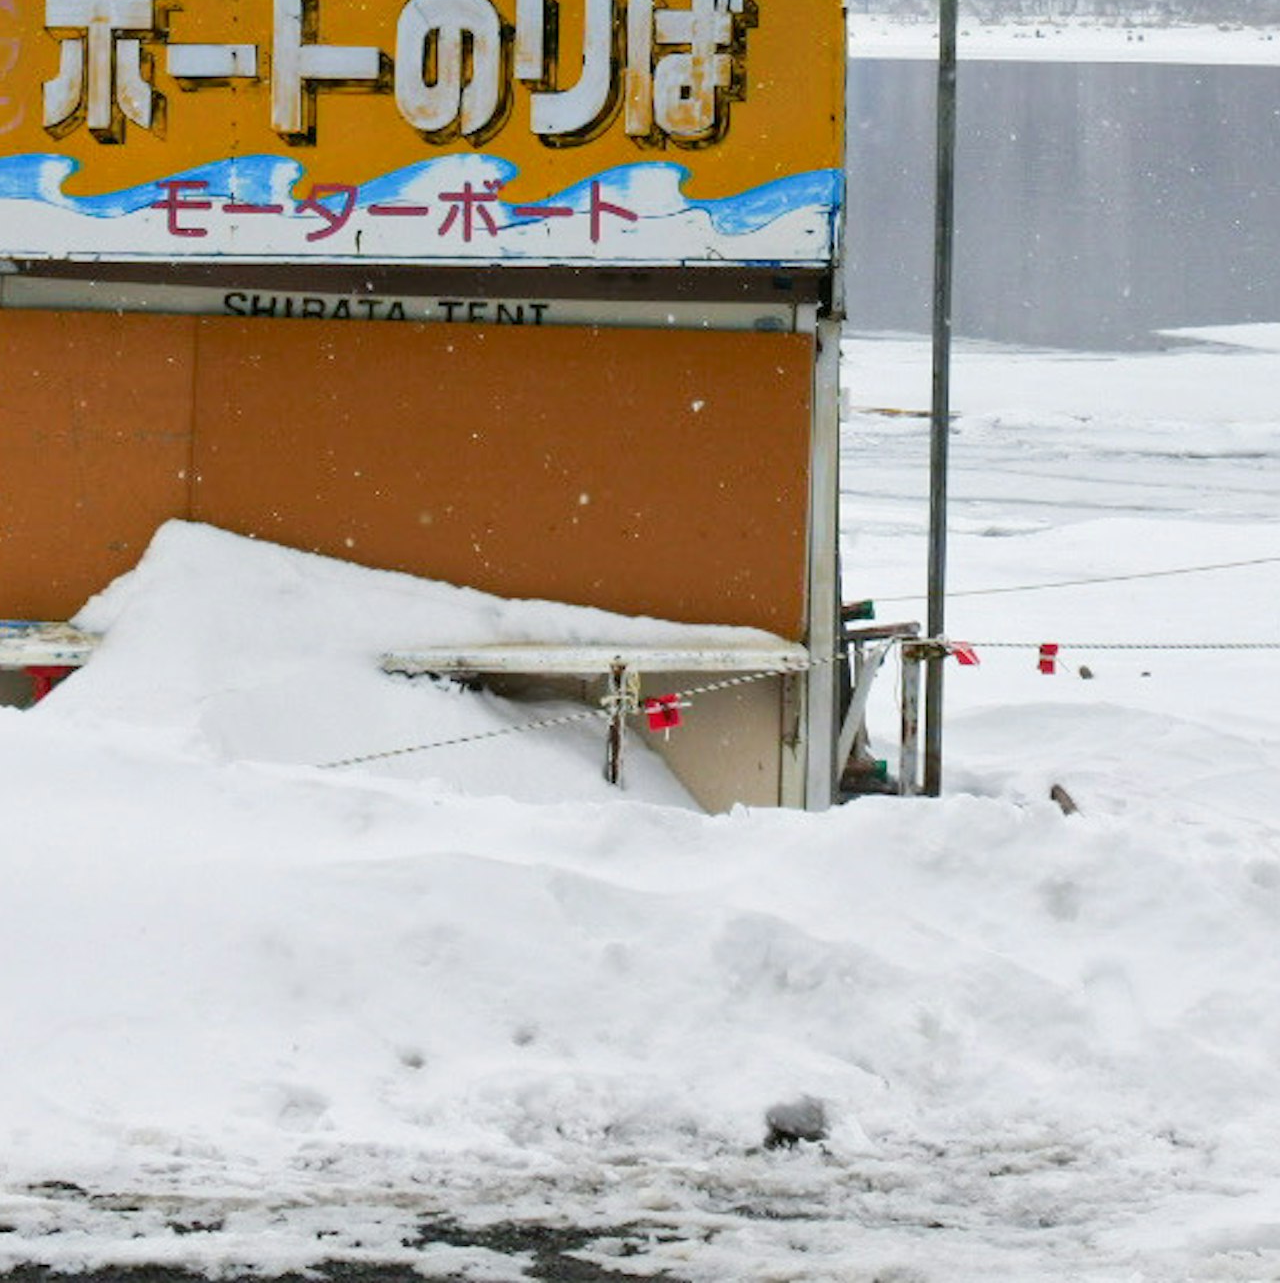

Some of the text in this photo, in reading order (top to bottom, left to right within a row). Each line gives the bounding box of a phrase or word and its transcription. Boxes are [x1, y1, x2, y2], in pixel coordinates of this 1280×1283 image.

[151, 180, 639, 244] モーターボート
